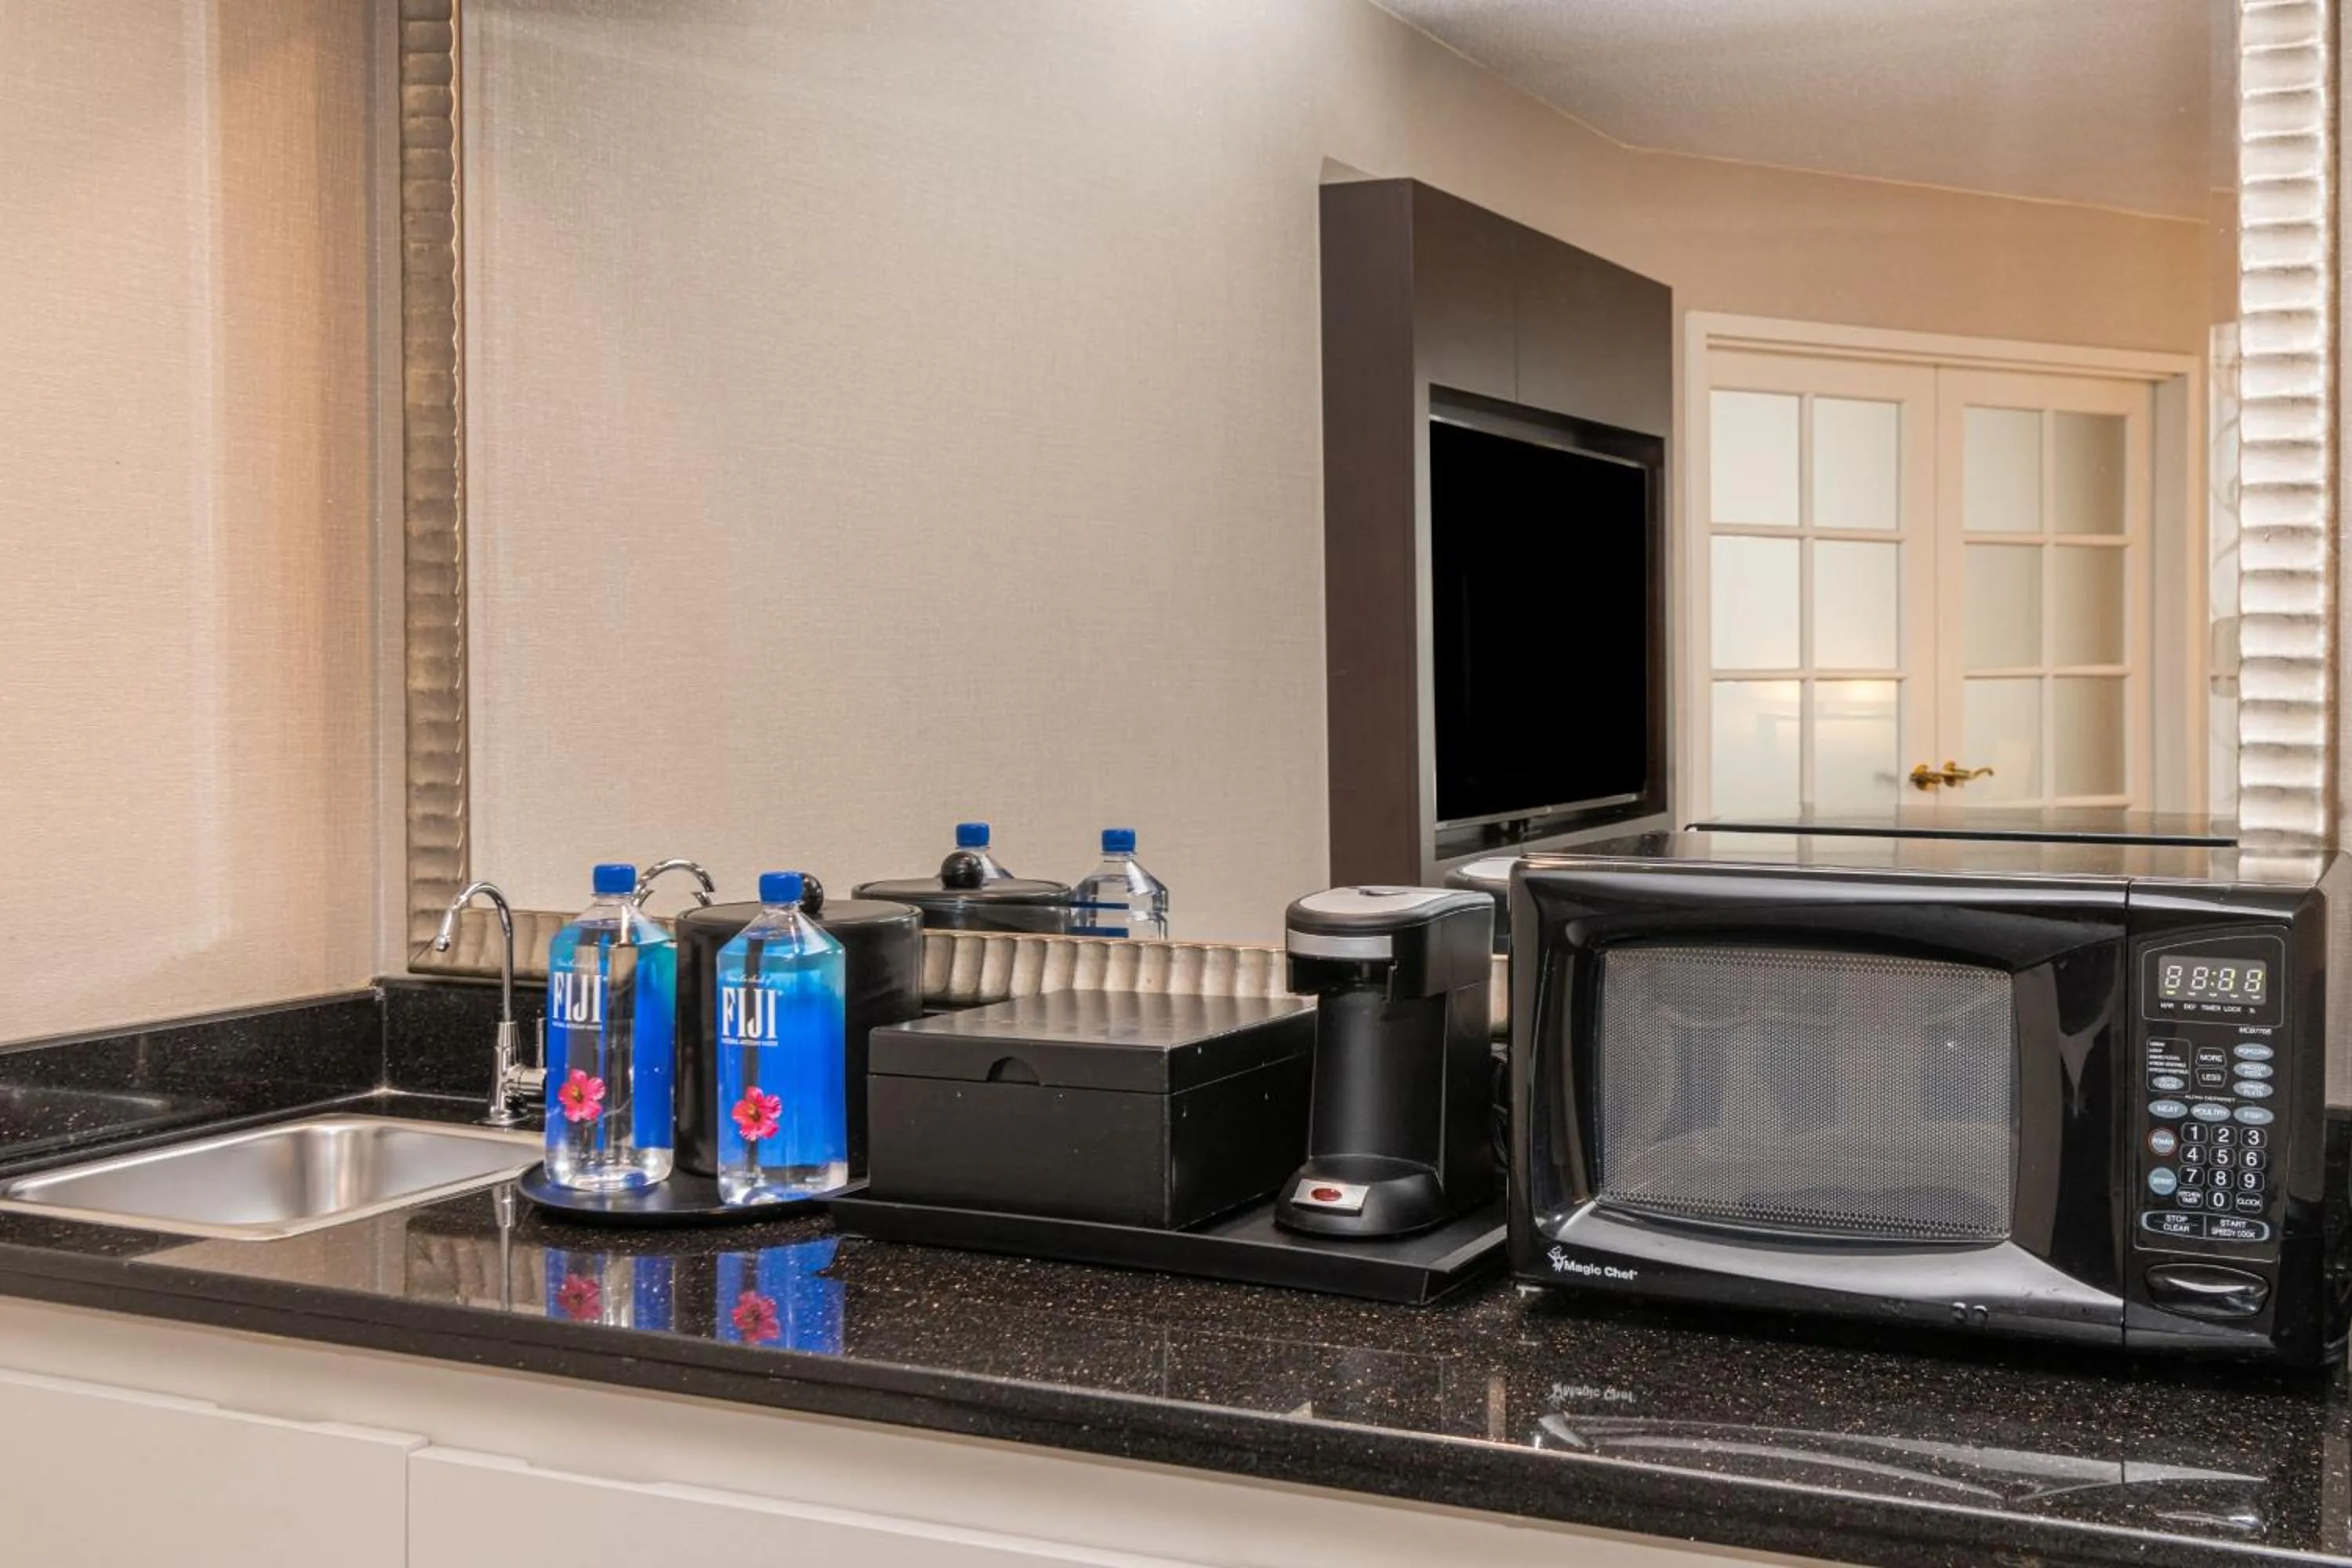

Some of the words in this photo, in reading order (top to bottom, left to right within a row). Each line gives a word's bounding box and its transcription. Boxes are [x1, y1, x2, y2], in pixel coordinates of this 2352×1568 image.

[552, 971, 603, 1022] FIJI
[721, 986, 778, 1039] FIJI
[2199, 1054, 2223, 1063] MORE
[2157, 1105, 2178, 1113] MEAT
[2194, 1107, 2227, 1116] POULTRY
[2190, 1126, 2198, 1141] 1
[2218, 1128, 2229, 1142] 2
[2248, 1130, 2259, 1145] 3
[2187, 1147, 2198, 1161] 4
[2216, 1149, 2228, 1164] 5
[2245, 1152, 2257, 1167] 6
[2186, 1168, 2198, 1183] 7
[2215, 1171, 2227, 1186] 8
[2244, 1173, 2256, 1189] 9
[2213, 1192, 2224, 1207] 0
[2237, 1197, 2260, 1206] CLOCK
[2163, 1224, 2190, 1232] CLEAR
[2220, 1219, 2246, 1228] START
[2211, 1227, 2236, 1236] SPEEDY
[2237, 1229, 2256, 1239] COOK
[1564, 1260, 1602, 1276] Magic
[1604, 1266, 1635, 1280] Chef
